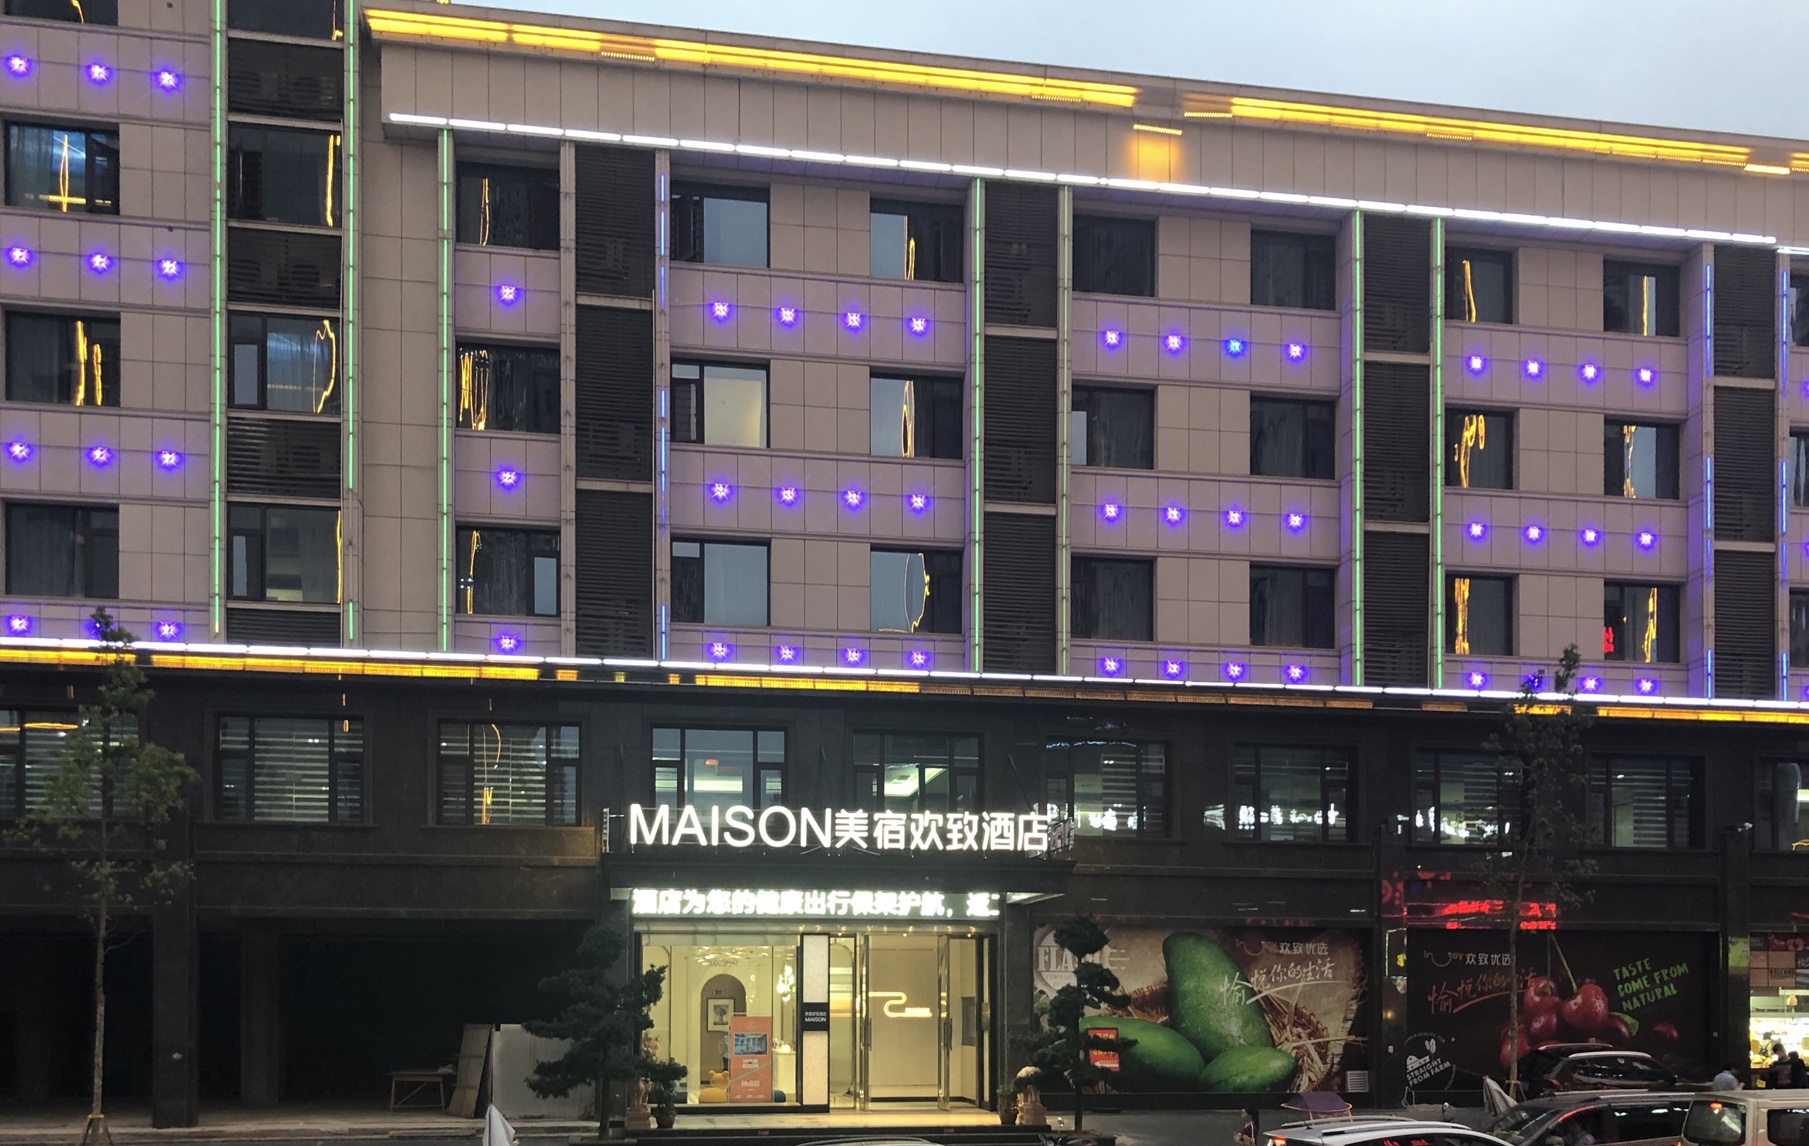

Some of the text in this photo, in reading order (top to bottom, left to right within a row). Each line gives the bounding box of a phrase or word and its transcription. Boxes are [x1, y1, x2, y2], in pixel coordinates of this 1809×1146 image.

[630, 803, 832, 848] MAISON
[835, 809, 1051, 851] 美宿欢致酒店
[1612, 957, 1652, 981] TASTE
[1617, 962, 1689, 997] COME FROM
[1427, 967, 1537, 1015] 愉悦你的活
[1621, 983, 1678, 1012] NATURAL
[1406, 1057, 1442, 1081] STRAIGHT
[1408, 1072, 1430, 1087] FROM
[1430, 1060, 1452, 1076] FARM
